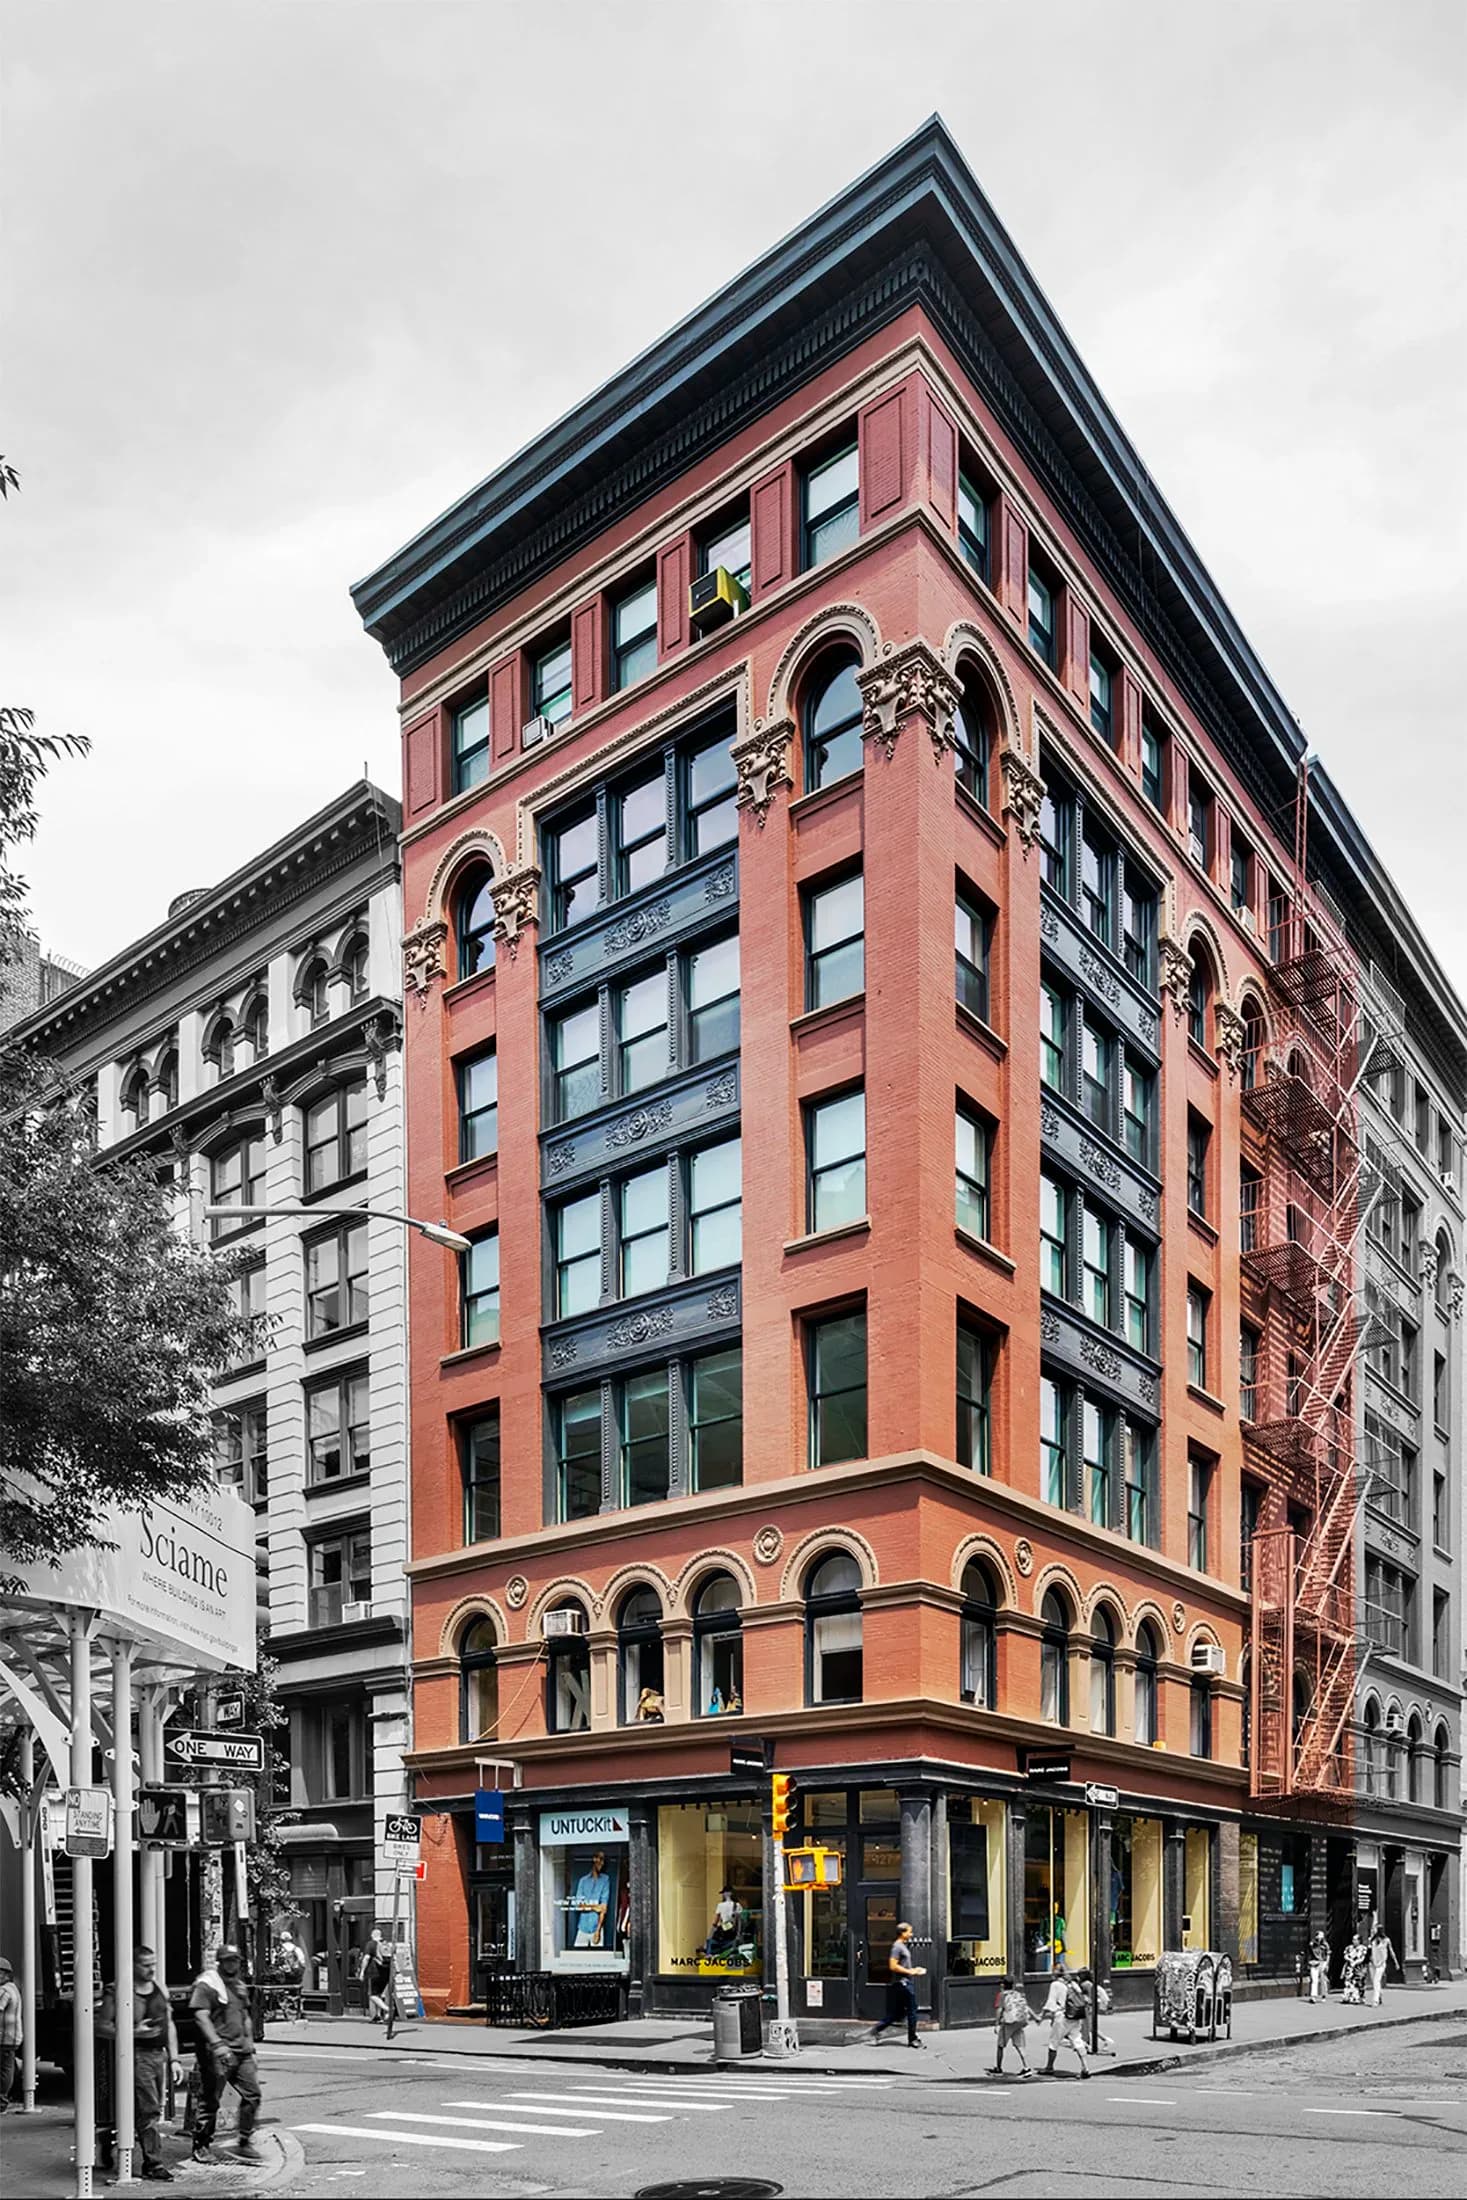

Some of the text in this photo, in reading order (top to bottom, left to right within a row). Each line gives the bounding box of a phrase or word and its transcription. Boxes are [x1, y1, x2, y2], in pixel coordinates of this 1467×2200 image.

[140, 1509, 228, 1598] Sciame
[175, 1740, 254, 1760] ONE WAY
[69, 1791, 80, 1807] NO
[73, 1809, 102, 1821] STANDING
[75, 1819, 101, 1830] ANYTIME
[551, 1816, 612, 1835] UNTUCKit
[386, 1833, 418, 1842] BIKE LANE
[670, 1957, 752, 1968] MARC JACOBS
[974, 1955, 1006, 1967] JACOBS
